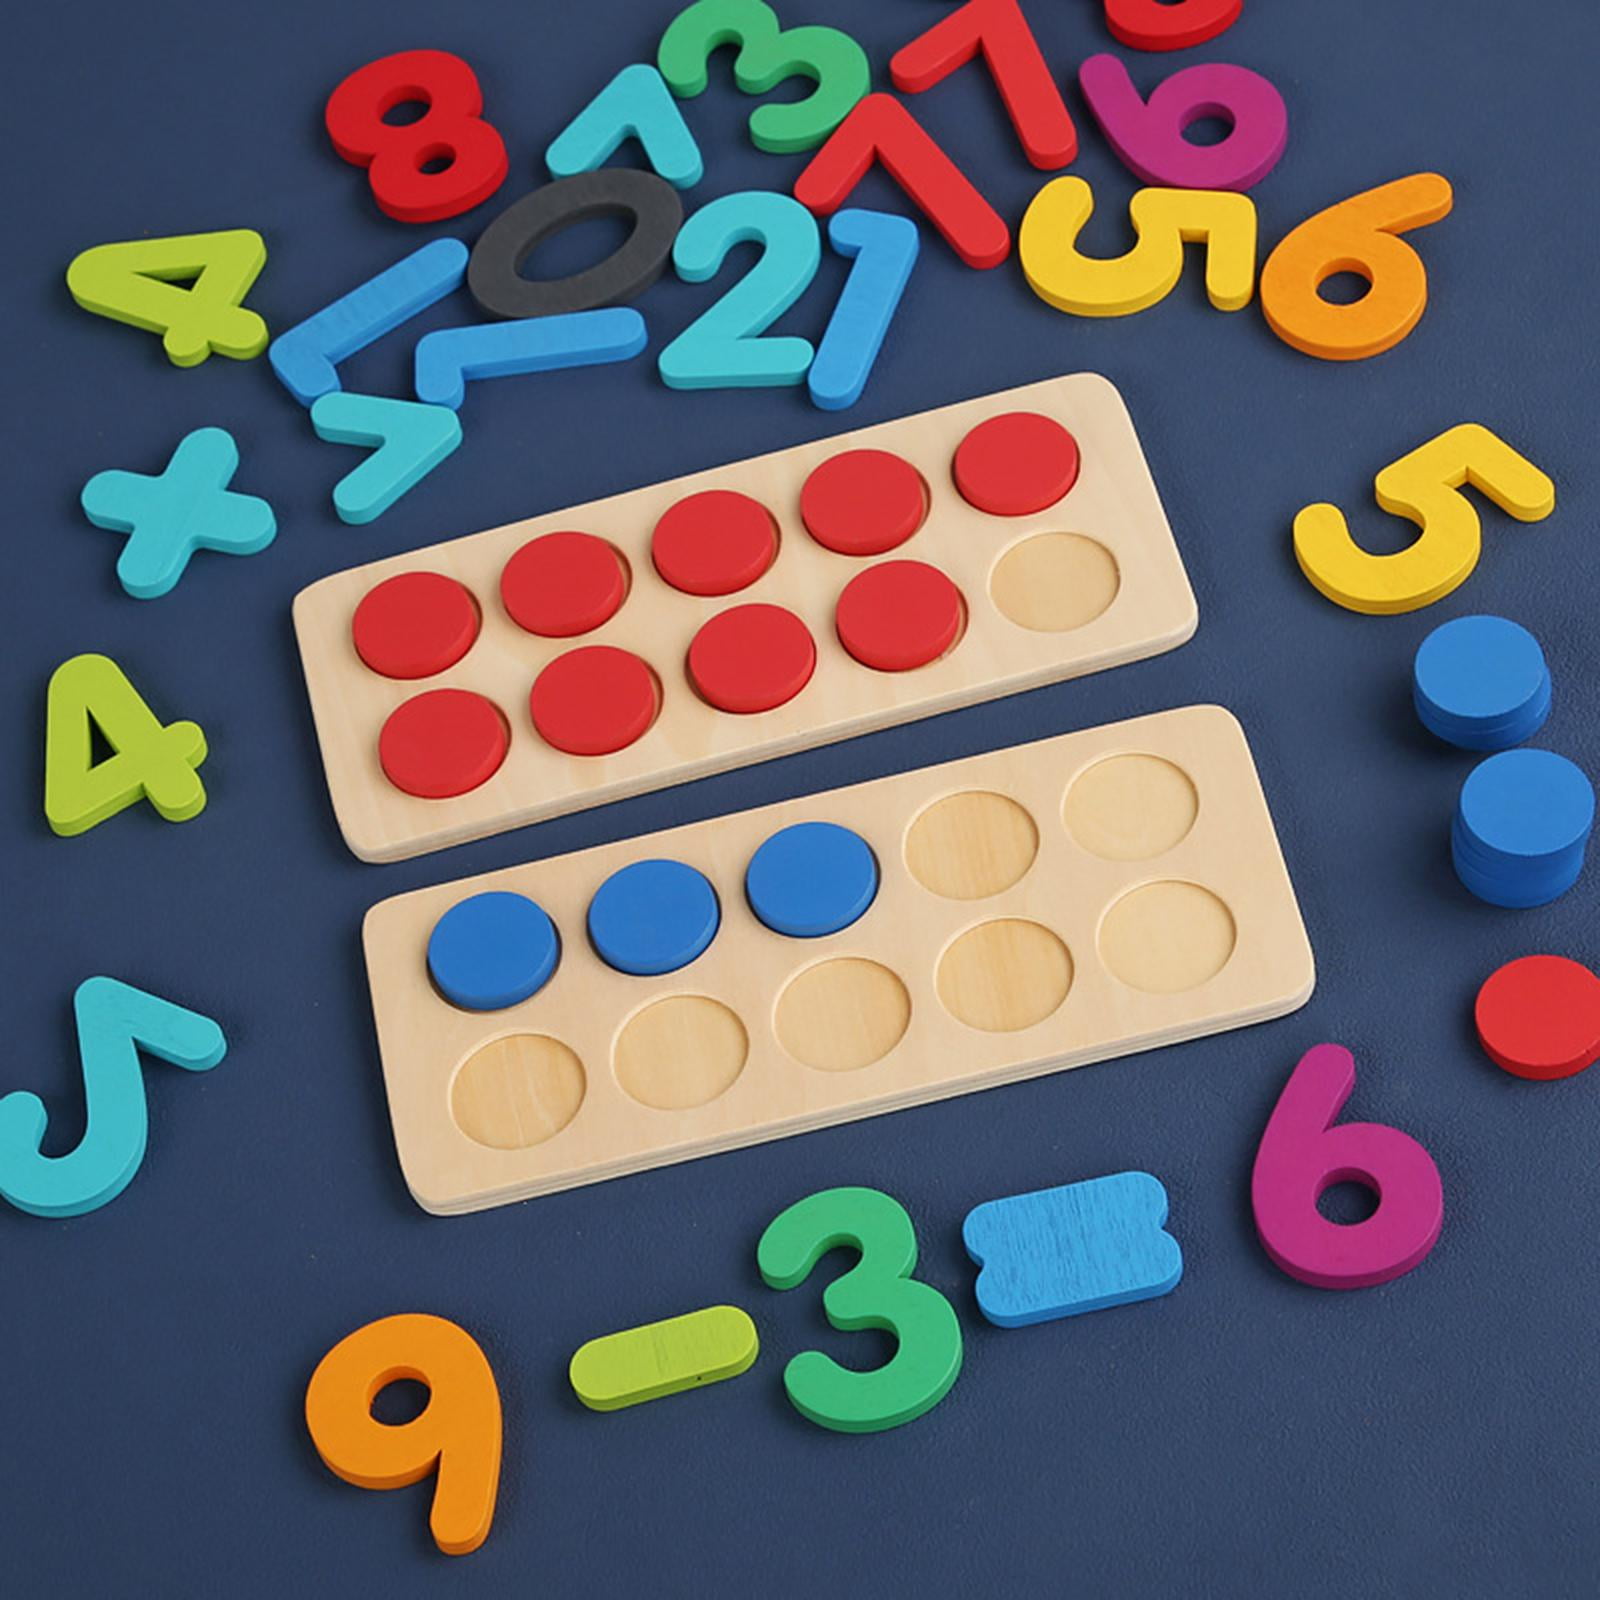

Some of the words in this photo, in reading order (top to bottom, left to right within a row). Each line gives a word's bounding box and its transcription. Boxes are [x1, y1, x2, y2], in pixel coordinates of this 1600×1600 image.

[326, 50, 508, 222] 8
[67, 229, 268, 366] 4
[658, 190, 822, 391] 2
[806, 208, 920, 411] 1
[1019, 176, 1257, 317] 5
[1293, 423, 1555, 614] 5
[45, 654, 208, 836] 4
[305, 1313, 502, 1555] 9
[758, 1187, 963, 1431] 3
[1252, 1043, 1443, 1290] 6
